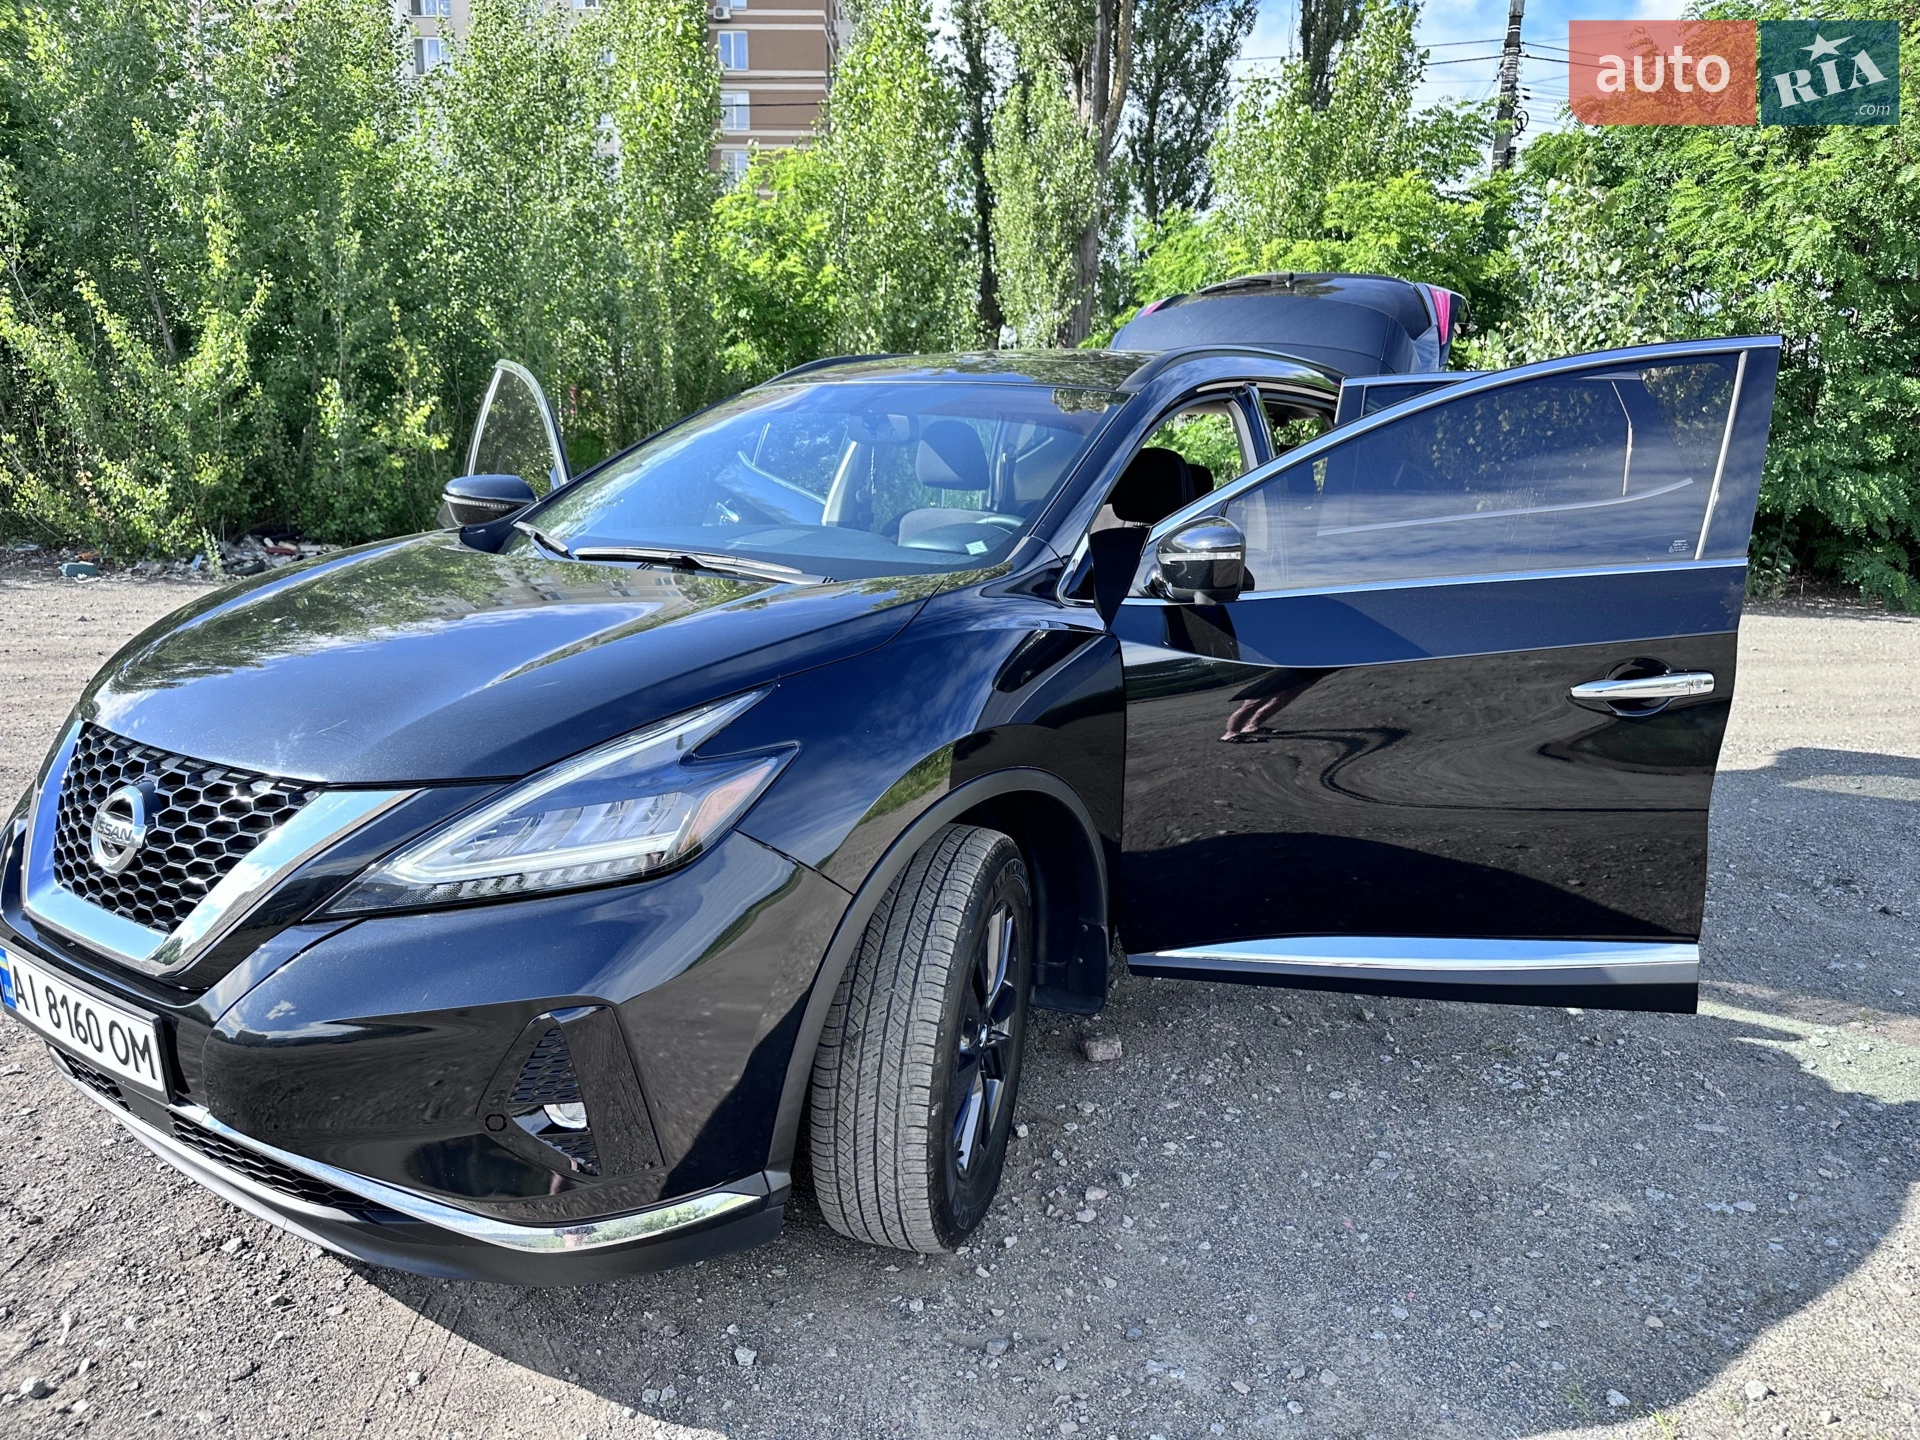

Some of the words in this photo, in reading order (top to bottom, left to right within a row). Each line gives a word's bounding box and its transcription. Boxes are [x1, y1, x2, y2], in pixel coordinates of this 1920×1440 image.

[13, 965, 40, 1018] AI
[44, 985, 104, 1053] 8160
[109, 1020, 157, 1080] OM
